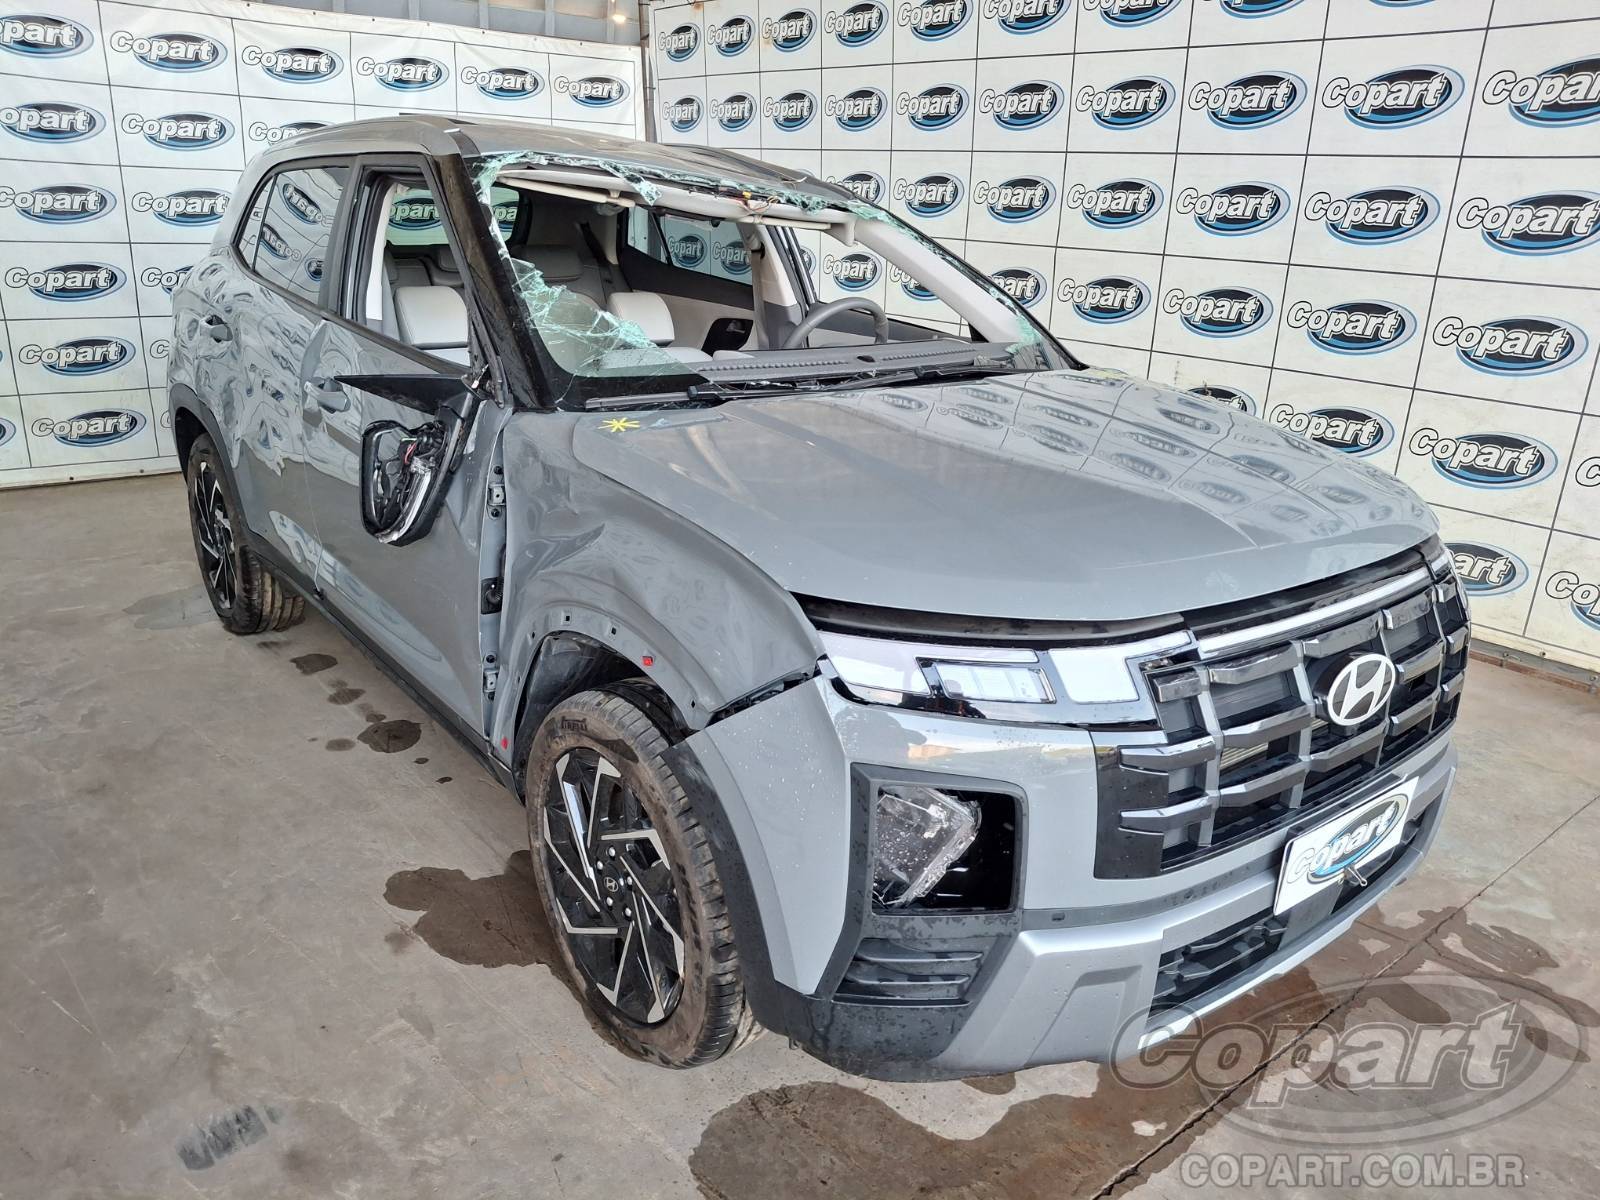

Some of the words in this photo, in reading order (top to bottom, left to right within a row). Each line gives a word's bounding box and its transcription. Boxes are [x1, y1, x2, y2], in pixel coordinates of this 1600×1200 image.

[762, 12, 810, 44] Copart
[824, 4, 880, 39] Copart
[897, 0, 962, 31] Copart
[0, 20, 77, 48] part
[110, 30, 213, 62] Copart
[658, 26, 696, 54] Copart
[707, 21, 749, 50] Copart
[242, 45, 332, 74] Copart
[356, 56, 439, 83] Copart
[460, 66, 536, 91] Copart
[553, 75, 621, 99] Copart
[709, 96, 749, 122] Copart
[763, 94, 810, 122] Copart
[824, 92, 882, 121] Copart
[896, 90, 960, 121] Copart
[979, 86, 1054, 119] Copart
[1075, 83, 1163, 117] Copart
[1188, 78, 1290, 117] Copart
[1322, 74, 1448, 115] Copart
[0, 107, 90, 132] opart
[662, 98, 699, 122] Copart
[121, 113, 220, 140] Copart
[131, 191, 227, 215] Copart
[893, 177, 956, 207] Copart
[973, 180, 1047, 210] Copart
[1067, 183, 1151, 215] Copart
[1176, 187, 1274, 222] Copart
[1304, 192, 1423, 230] Copart
[1457, 197, 1600, 241] Copart
[4, 266, 112, 292] Copart
[823, 254, 875, 281] Copart
[1057, 278, 1140, 310] Copart
[1163, 288, 1259, 324] Copart
[1287, 300, 1401, 339] Copart
[1433, 316, 1569, 360] Copart
[18, 340, 121, 368] Copart
[31, 412, 133, 440] Copart
[1269, 403, 1378, 446] Copart
[1409, 428, 1539, 476] Copart
[1286, 800, 1396, 884] Copart
